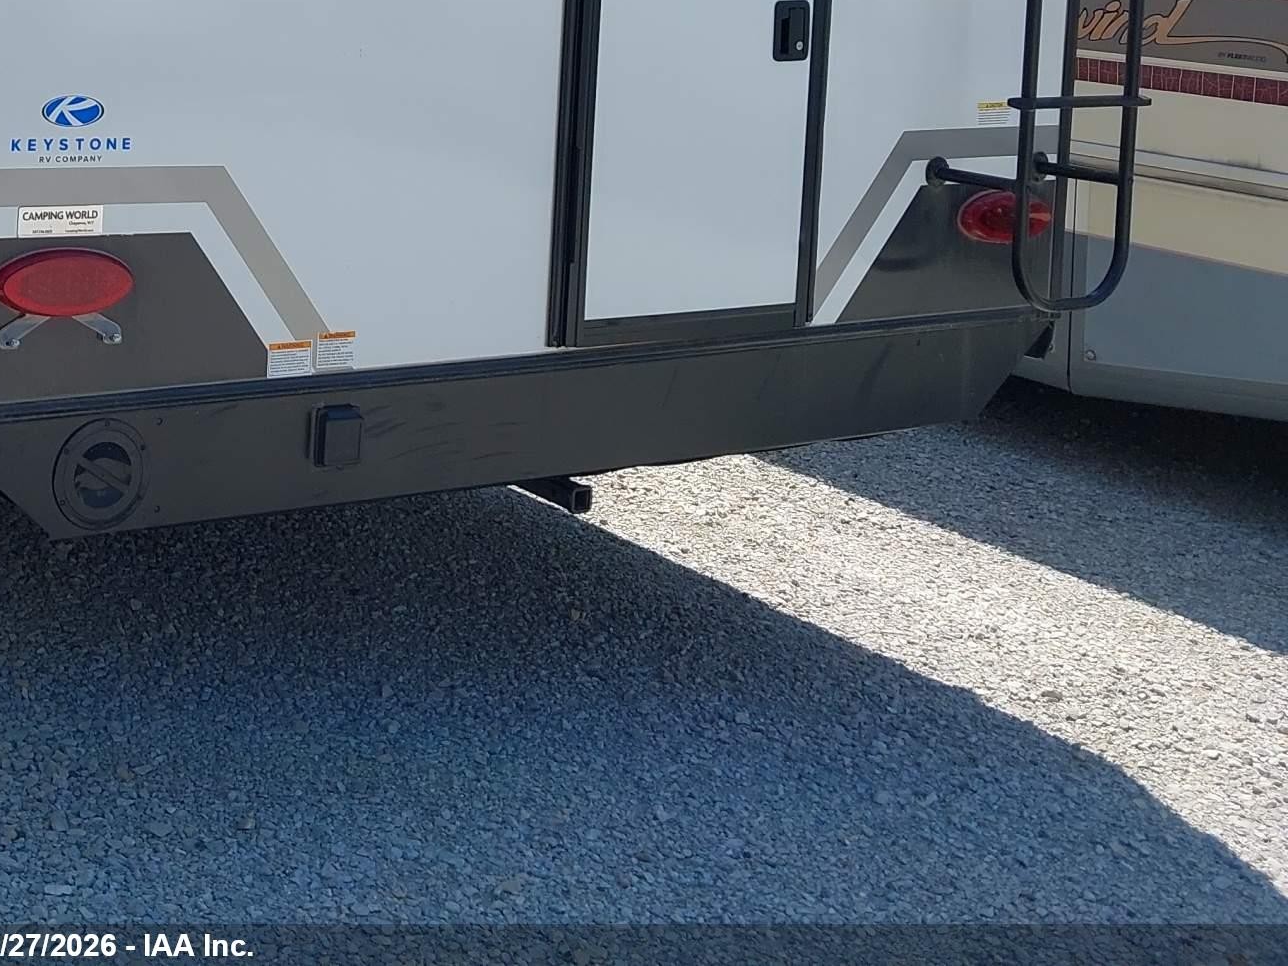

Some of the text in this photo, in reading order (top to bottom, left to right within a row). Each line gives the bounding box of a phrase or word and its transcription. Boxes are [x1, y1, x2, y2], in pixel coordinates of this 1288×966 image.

[11, 137, 131, 152] KEYSTONE
[55, 155, 103, 163] COMPANY
[22, 209, 99, 221] CAMPING WORLD
